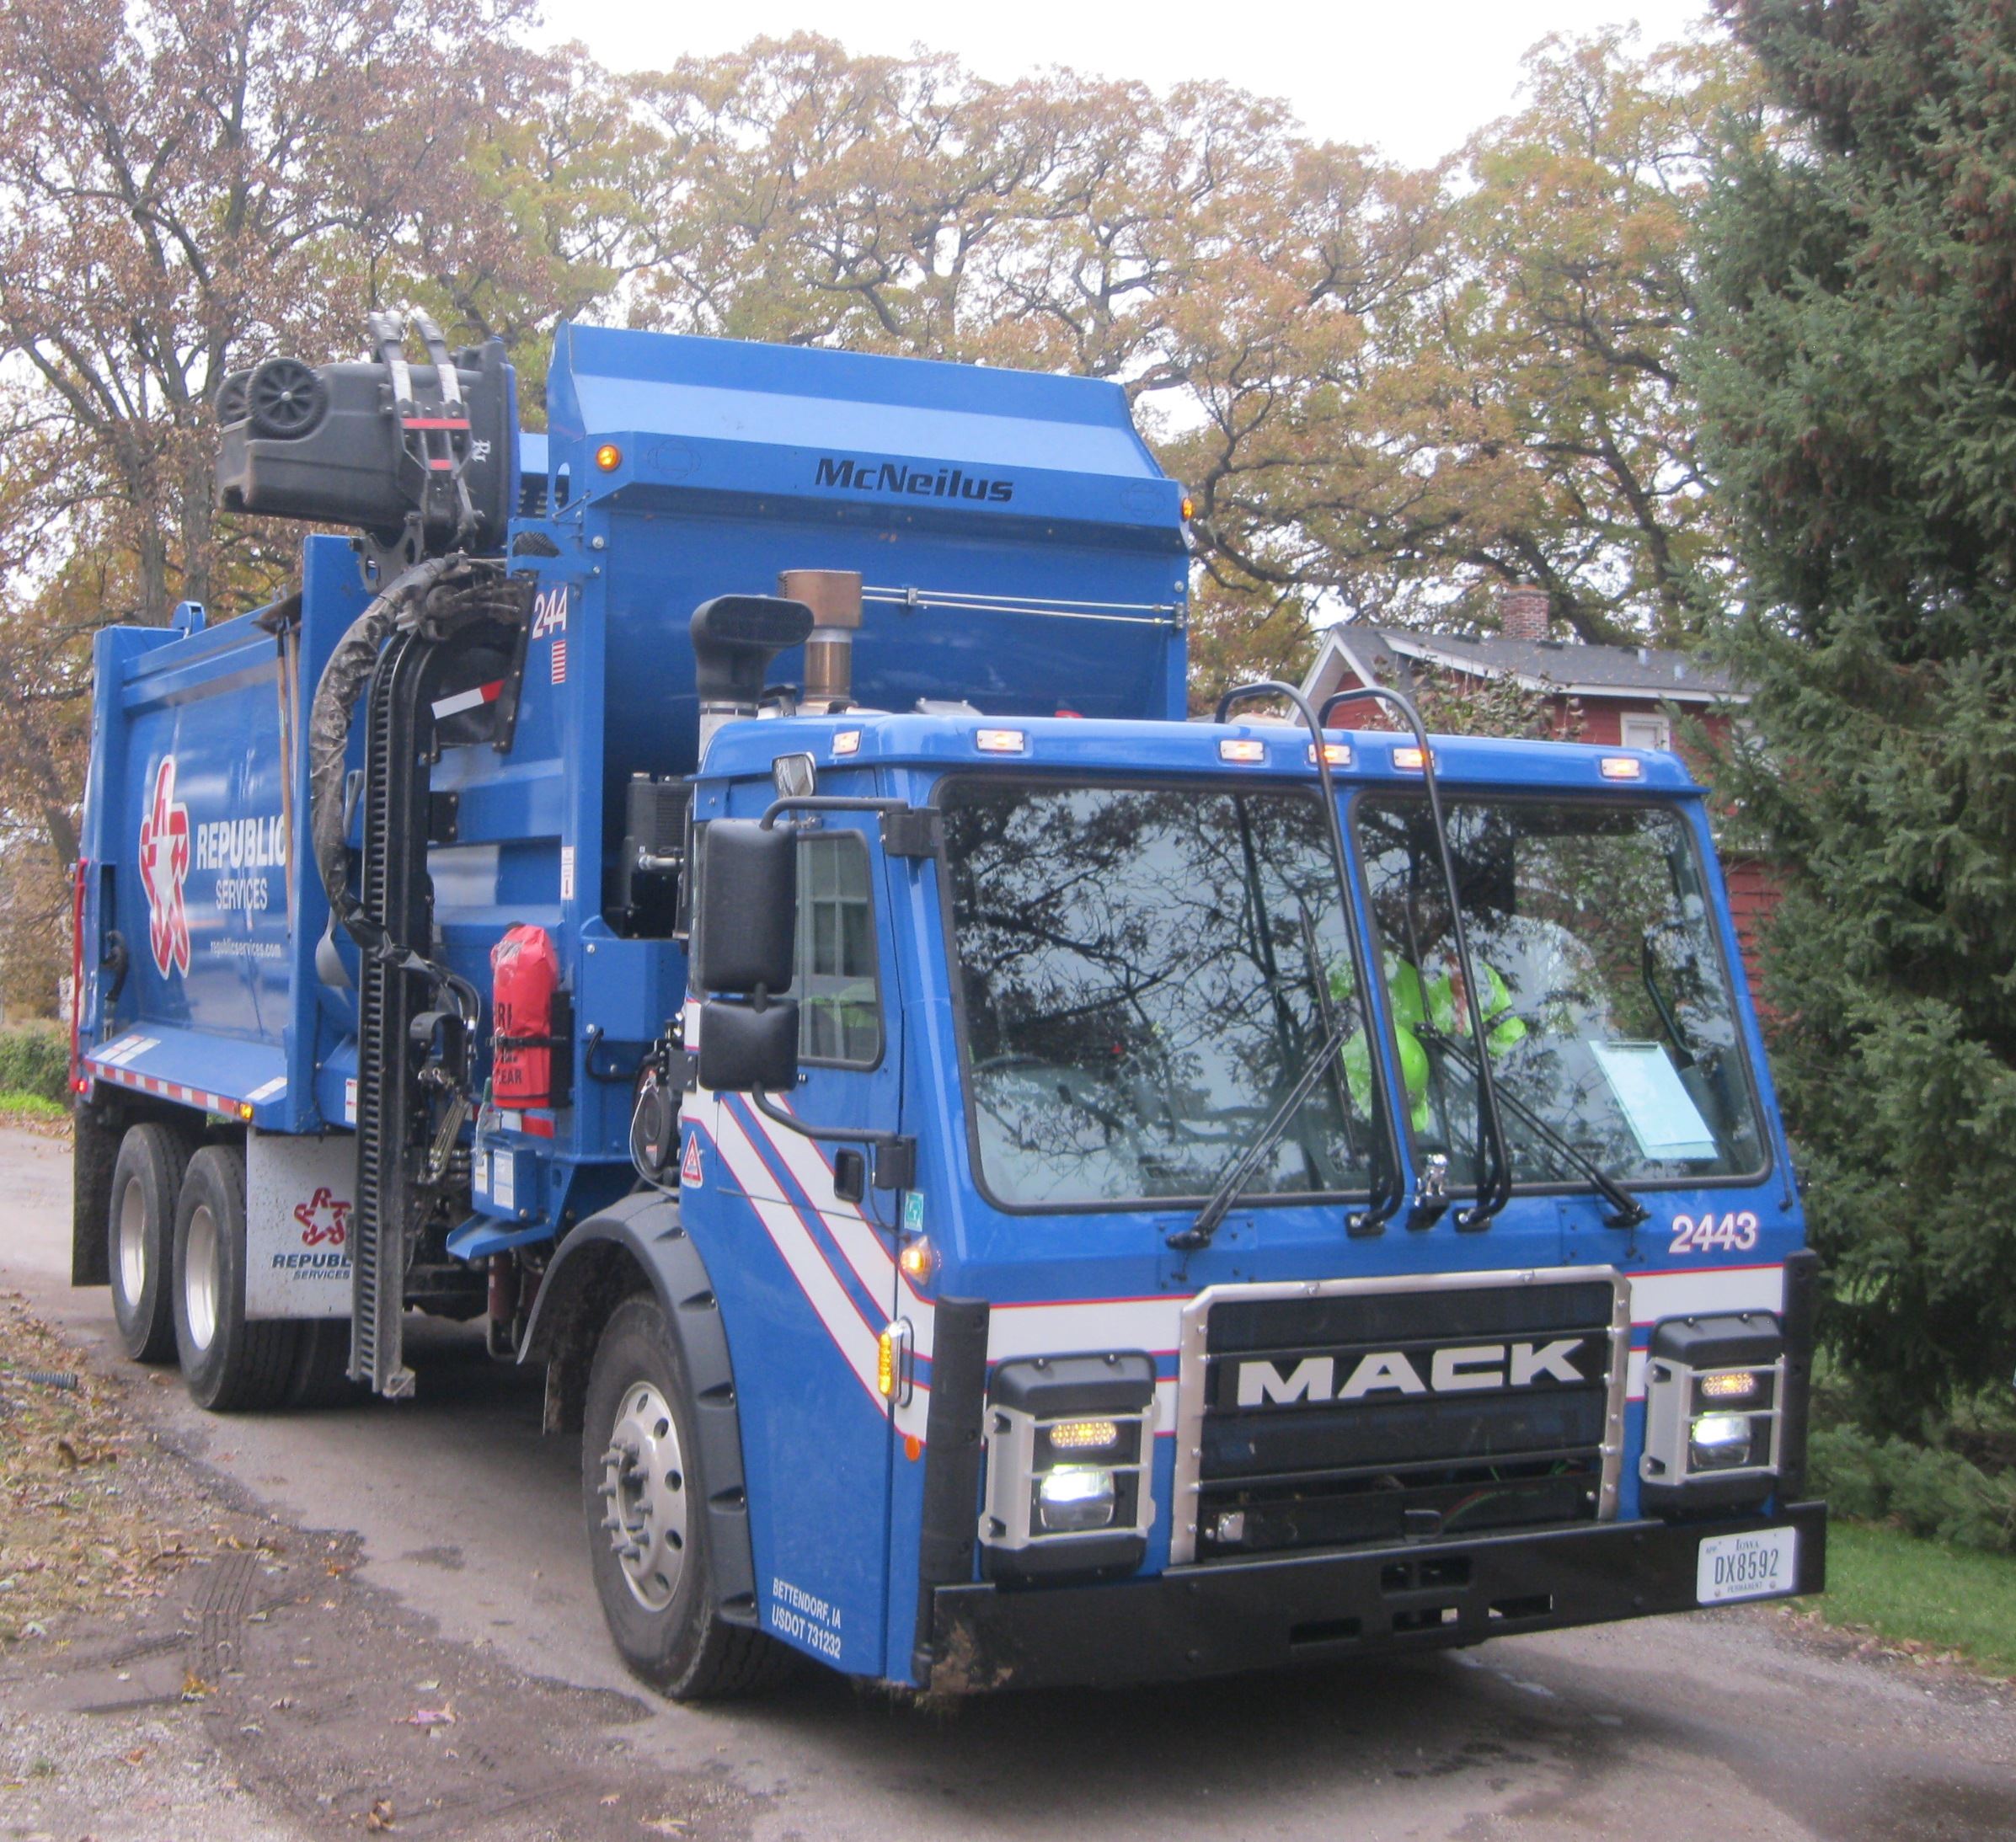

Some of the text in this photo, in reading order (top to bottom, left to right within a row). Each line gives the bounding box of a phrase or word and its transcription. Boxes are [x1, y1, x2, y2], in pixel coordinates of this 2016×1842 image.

[815, 457, 1014, 502] McNeilus
[196, 814, 287, 871] REPUBLIC
[216, 878, 268, 911] SERVICES
[1669, 1211, 1757, 1254] 2443
[271, 1252, 352, 1268] REPUBL
[293, 1269, 350, 1280] SERVICES
[1237, 1338, 1585, 1407] MACK
[1714, 1549, 1779, 1584] DX8592
[772, 1604, 841, 1659] USDOT 731232
[832, 1607, 842, 1630] IA
